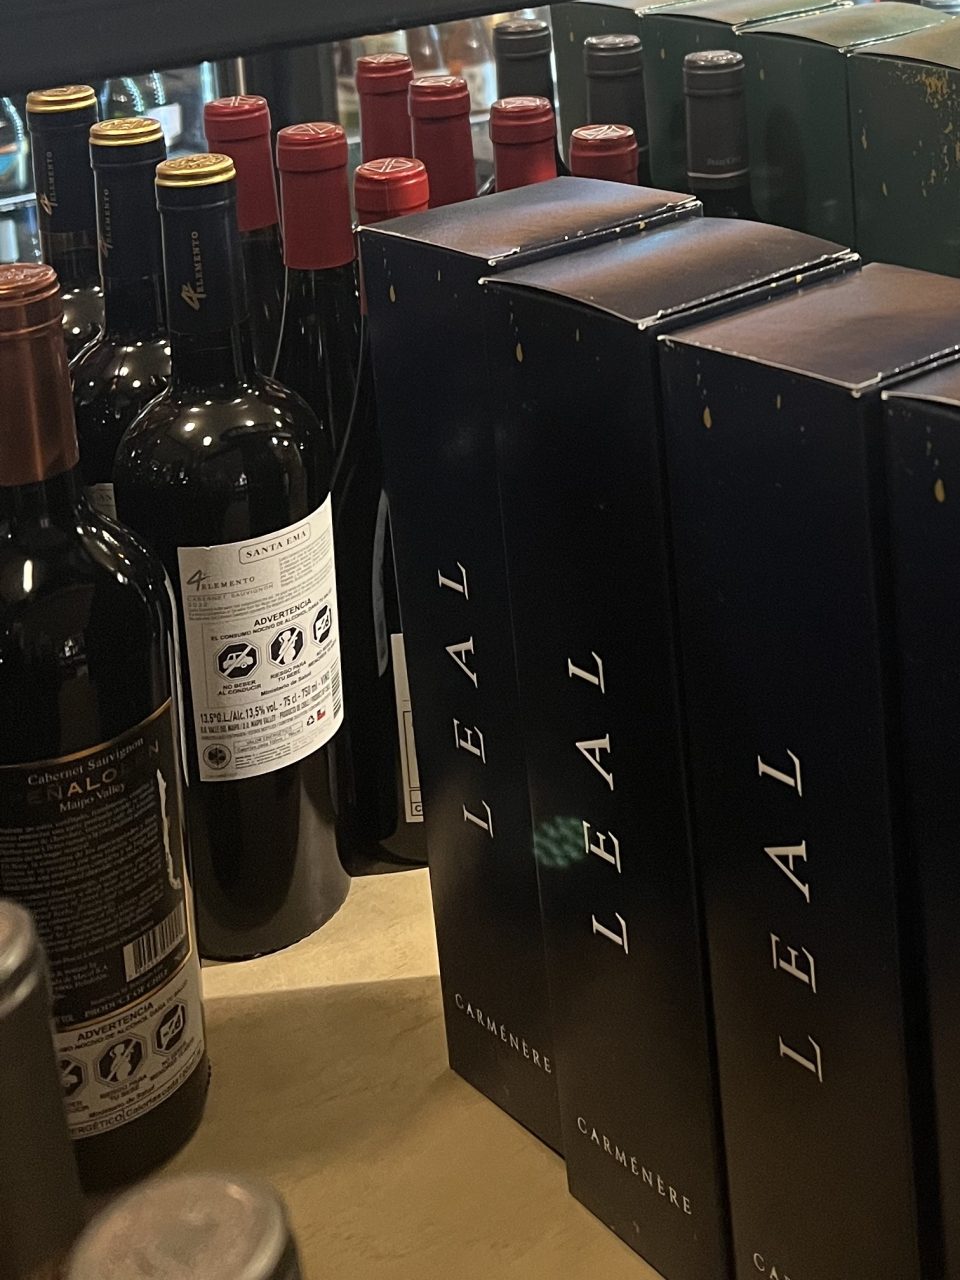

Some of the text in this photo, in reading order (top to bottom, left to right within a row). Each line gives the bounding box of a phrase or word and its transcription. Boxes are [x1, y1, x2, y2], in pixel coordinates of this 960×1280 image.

[191, 231, 204, 293] ELEMENTO
[246, 531, 306, 558] SANTA EMA
[201, 576, 255, 590] ELEMENTO
[231, 584, 274, 599] SAUVIGNON
[221, 631, 252, 640] CONSUMO
[253, 624, 275, 633] NOCIVO
[284, 610, 308, 623] ALCOHOL
[254, 598, 311, 627] ADVERTENCIA
[234, 680, 256, 688] BEBER
[270, 667, 292, 679] RIESGO
[228, 684, 261, 695] CONDUCIR
[261, 683, 290, 696] Ministerio
[438, 562, 493, 839] LEAL
[28, 737, 144, 786] Cabernet Sauvignon
[59, 783, 126, 813] Maipo Valley
[568, 651, 629, 955] LEAL
[757, 749, 823, 1083] LEAL
[77, 1002, 154, 1042] ADVERTENCIA
